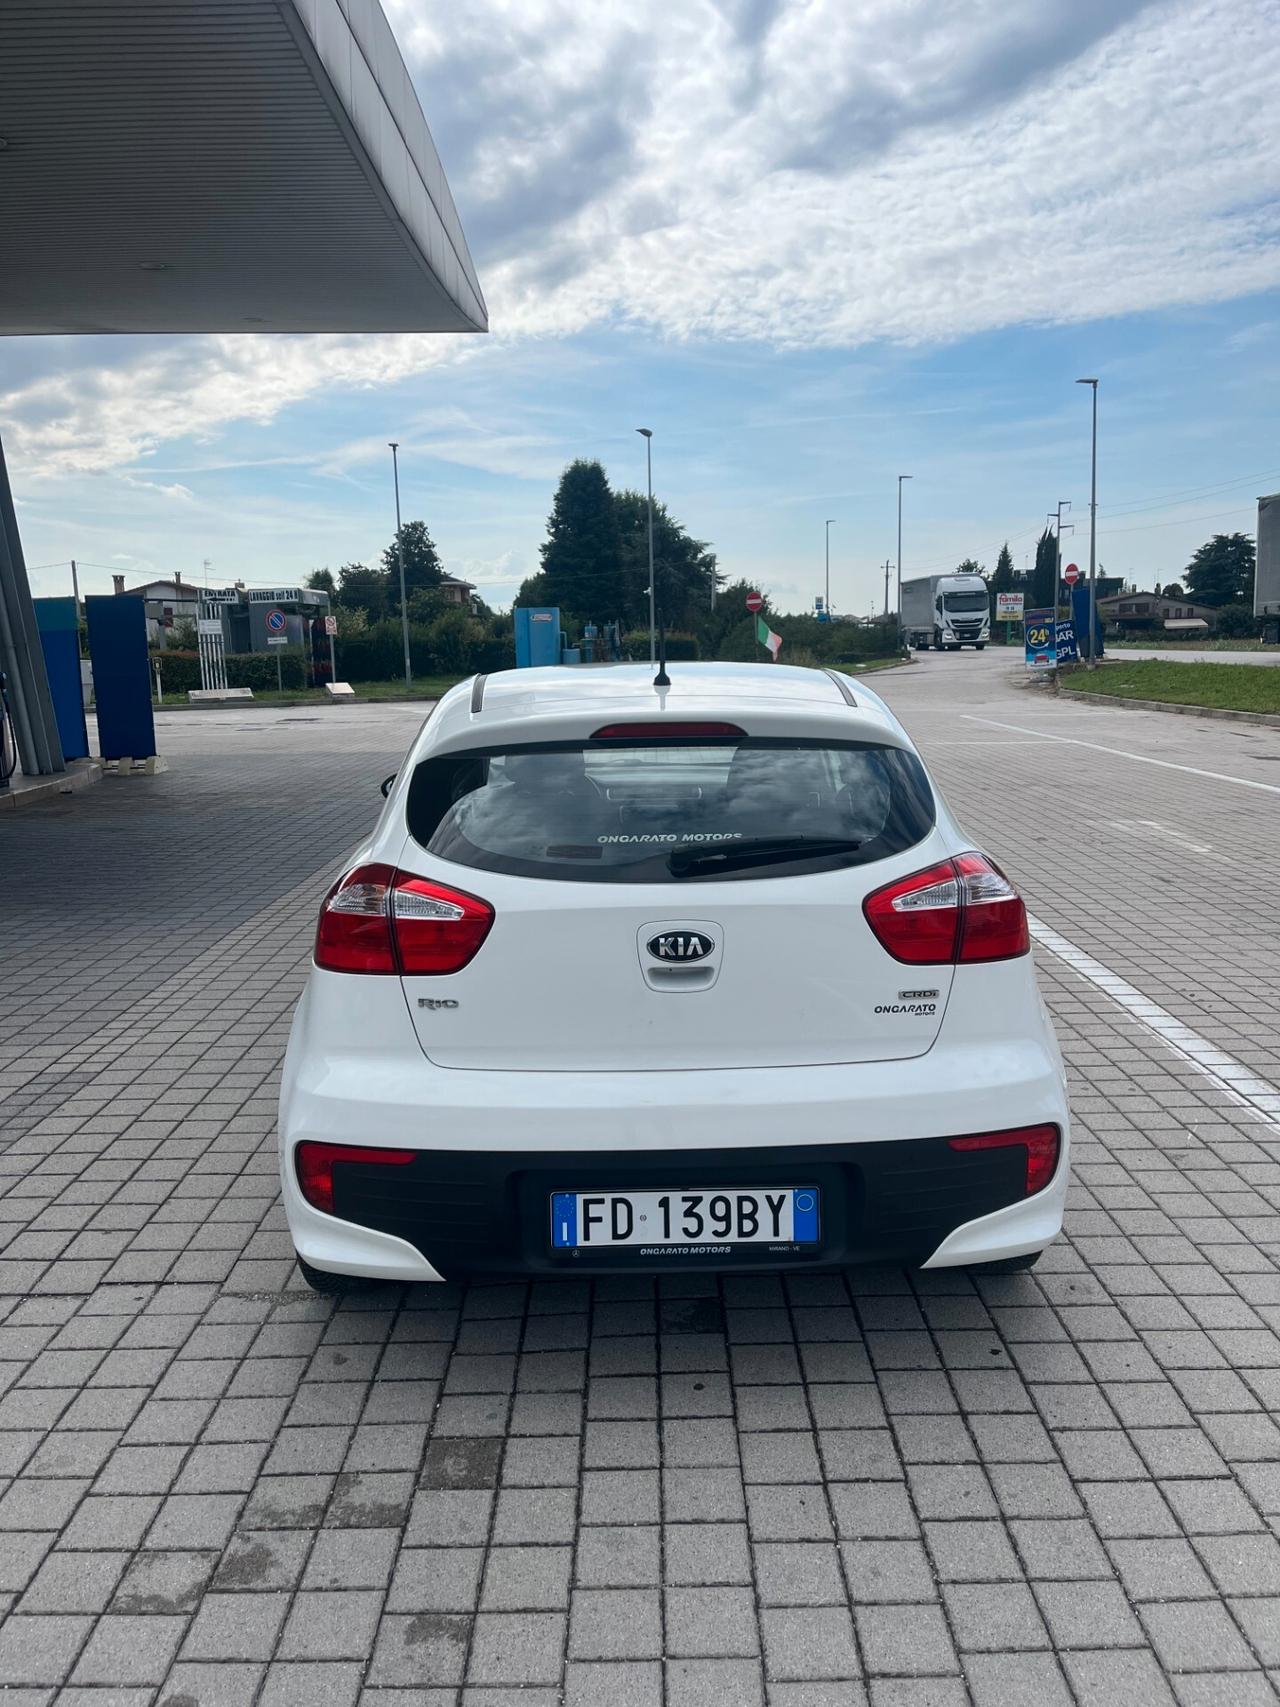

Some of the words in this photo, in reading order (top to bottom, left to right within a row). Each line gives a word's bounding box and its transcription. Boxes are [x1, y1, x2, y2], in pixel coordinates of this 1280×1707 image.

[250, 591, 275, 602] LAVAGGIO
[286, 590, 293, 600] 24
[1055, 623, 1071, 631] perto
[597, 834, 678, 843] ONGARATO
[658, 936, 704, 956] KIA
[874, 1003, 936, 1014] ONGARATO
[582, 1196, 634, 1242] FD
[658, 1194, 787, 1240] 139BY
[640, 1247, 689, 1255] ONGARATO
[690, 1246, 732, 1254] MOTORS
